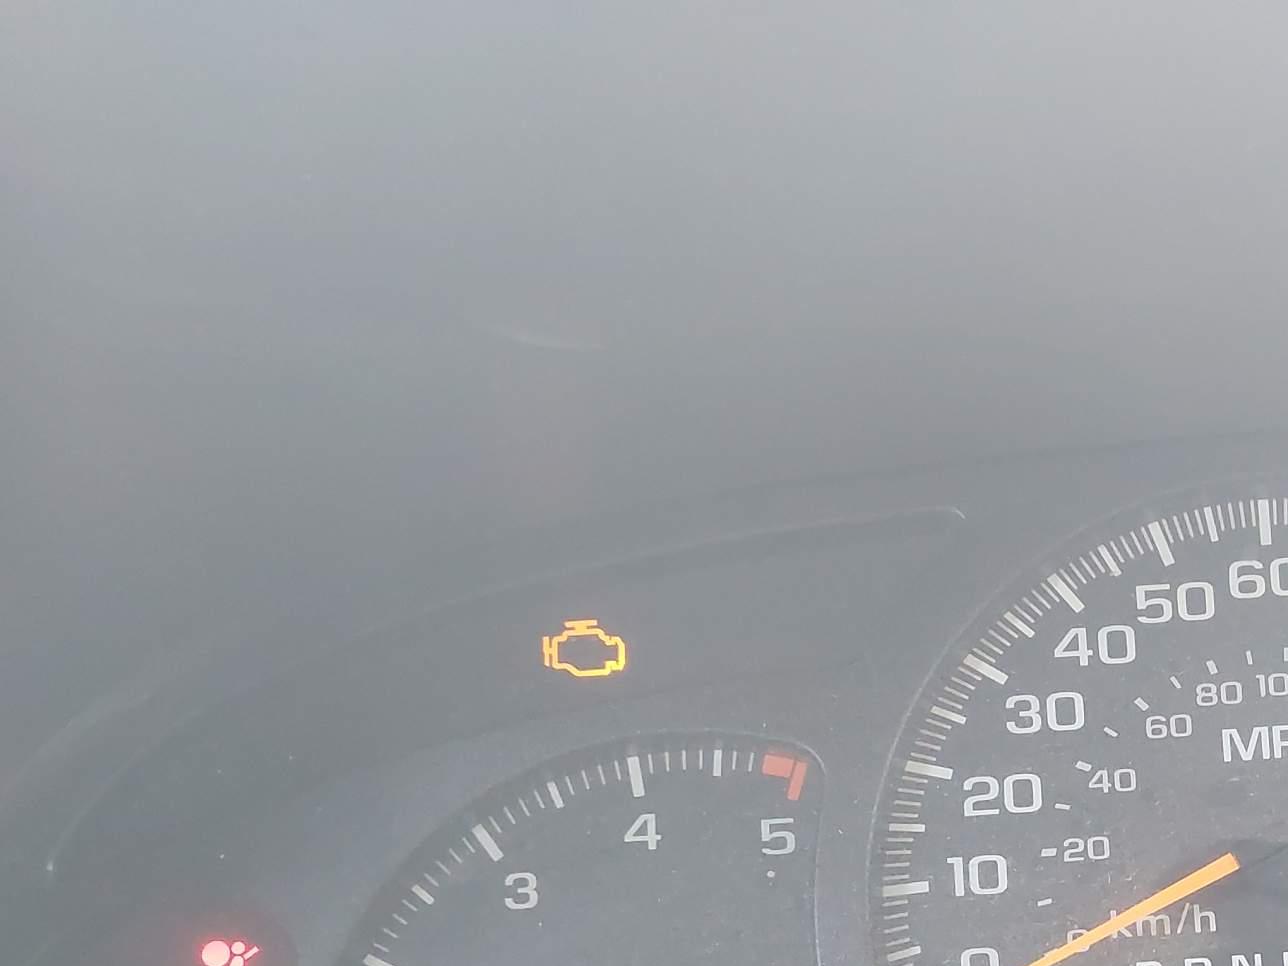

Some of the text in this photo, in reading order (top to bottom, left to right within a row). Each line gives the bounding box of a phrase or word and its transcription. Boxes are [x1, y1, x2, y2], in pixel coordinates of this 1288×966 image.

[1135, 581, 1215, 624] 50
[1054, 625, 1136, 666] 40
[1195, 680, 1243, 706] 80
[1005, 691, 1085, 734] 30
[1145, 714, 1193, 739] 60
[963, 773, 1043, 816] 20
[1088, 769, 1136, 793] 40
[624, 813, 662, 850] 4
[760, 816, 796, 855] 5
[1062, 836, 1111, 862] 20
[504, 872, 539, 909] 3
[947, 854, 1009, 897] 10
